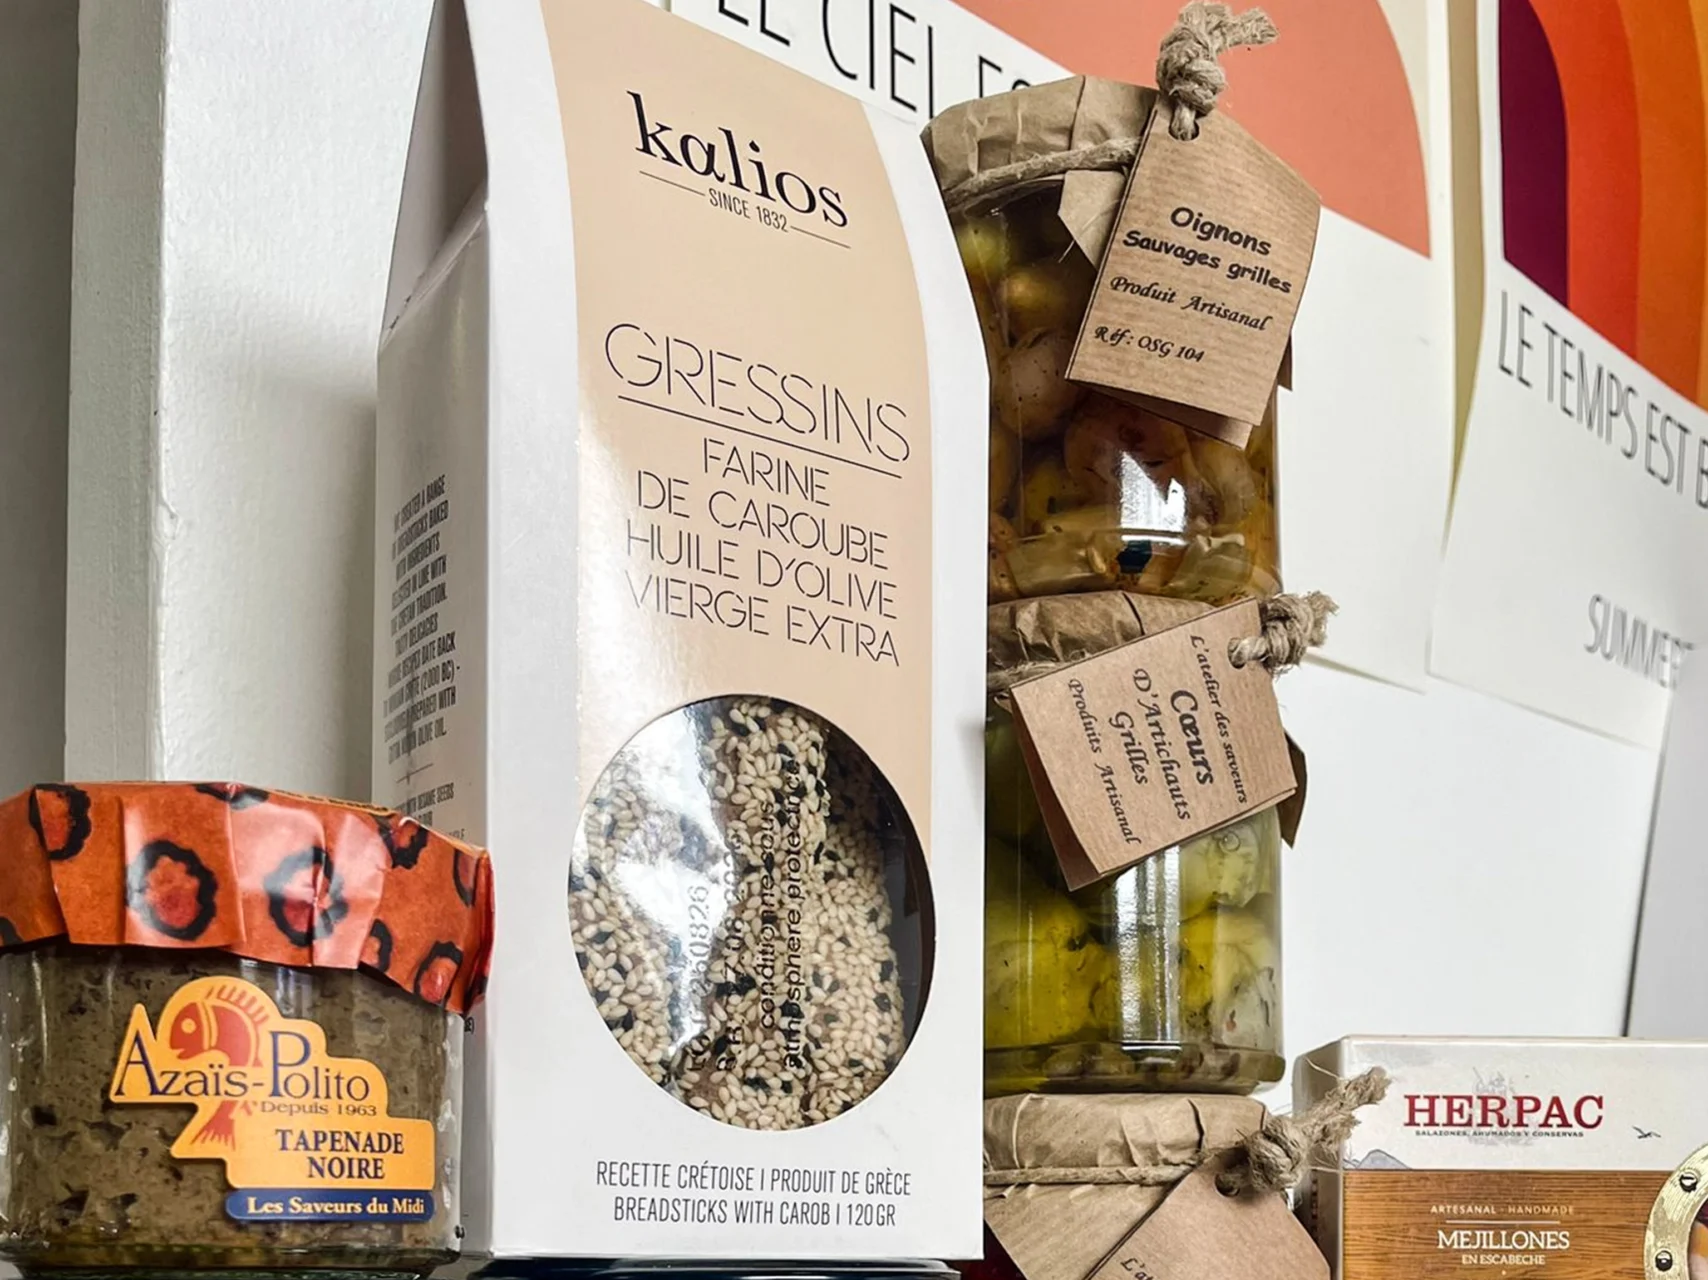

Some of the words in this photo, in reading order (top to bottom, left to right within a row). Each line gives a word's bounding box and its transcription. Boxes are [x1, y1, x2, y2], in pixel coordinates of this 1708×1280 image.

[626, 90, 849, 228] kalios
[709, 188, 751, 219] SINCE
[756, 205, 788, 233] 1832
[1171, 207, 1272, 256] Oignons
[1123, 230, 1221, 269] Sauvages
[1226, 262, 1292, 294] grilles
[1110, 276, 1176, 304] Produit
[1180, 295, 1273, 331] Artisanal
[1138, 335, 1175, 359] OSG
[1178, 345, 1204, 363] 104
[605, 323, 910, 462] GRESSINS
[1499, 290, 1532, 388] LE
[1542, 321, 1639, 460] TEMPS
[1645, 402, 1691, 495] EST
[703, 437, 830, 507] FARINE
[638, 470, 690, 519] DE
[708, 490, 888, 570] CAROUBE
[626, 518, 739, 580] HUILE
[757, 548, 898, 620] D'OLIVE
[624, 569, 770, 636] VIERGE
[786, 604, 900, 668] EXTRA
[1132, 667, 1191, 821] D'Artichauts
[1170, 689, 1214, 786] Cœurs
[1190, 634, 1222, 709] L'atelier
[1214, 709, 1229, 740] des
[1223, 741, 1248, 805] saveurs
[1068, 678, 1102, 754] Produits
[1094, 761, 1142, 845] Artisanal
[1109, 710, 1149, 785] Grilles
[114, 1030, 370, 1101] Azaïs-Polito
[261, 1101, 329, 1117] Depuis
[337, 1103, 377, 1117] 1963
[1403, 1094, 1604, 1130] HERPAC
[1532, 1130, 1584, 1138] CONSERVAS
[275, 1128, 404, 1155] TAPENADE
[307, 1156, 385, 1180] NOIRE
[597, 1160, 671, 1188] RECETTE
[677, 1159, 755, 1191] CRÉTOISE
[770, 1168, 836, 1194] PRODUIT
[841, 1170, 860, 1195] DE
[865, 1167, 912, 1196] GRÈCE
[247, 1196, 286, 1215] Les
[289, 1197, 362, 1215] Saveurs
[367, 1198, 389, 1214] du
[392, 1199, 425, 1214] Midi
[614, 1196, 728, 1224] BREADSTICKS
[734, 1200, 774, 1224] WITH
[779, 1201, 831, 1226] CAROB
[1430, 1204, 1497, 1215] ARTESANAL
[1508, 1205, 1575, 1216] HANDMADE
[1437, 1230, 1570, 1251] MEJILLONES
[1462, 1254, 1479, 1265] EN
[1480, 1254, 1546, 1265] ESCABECHE
